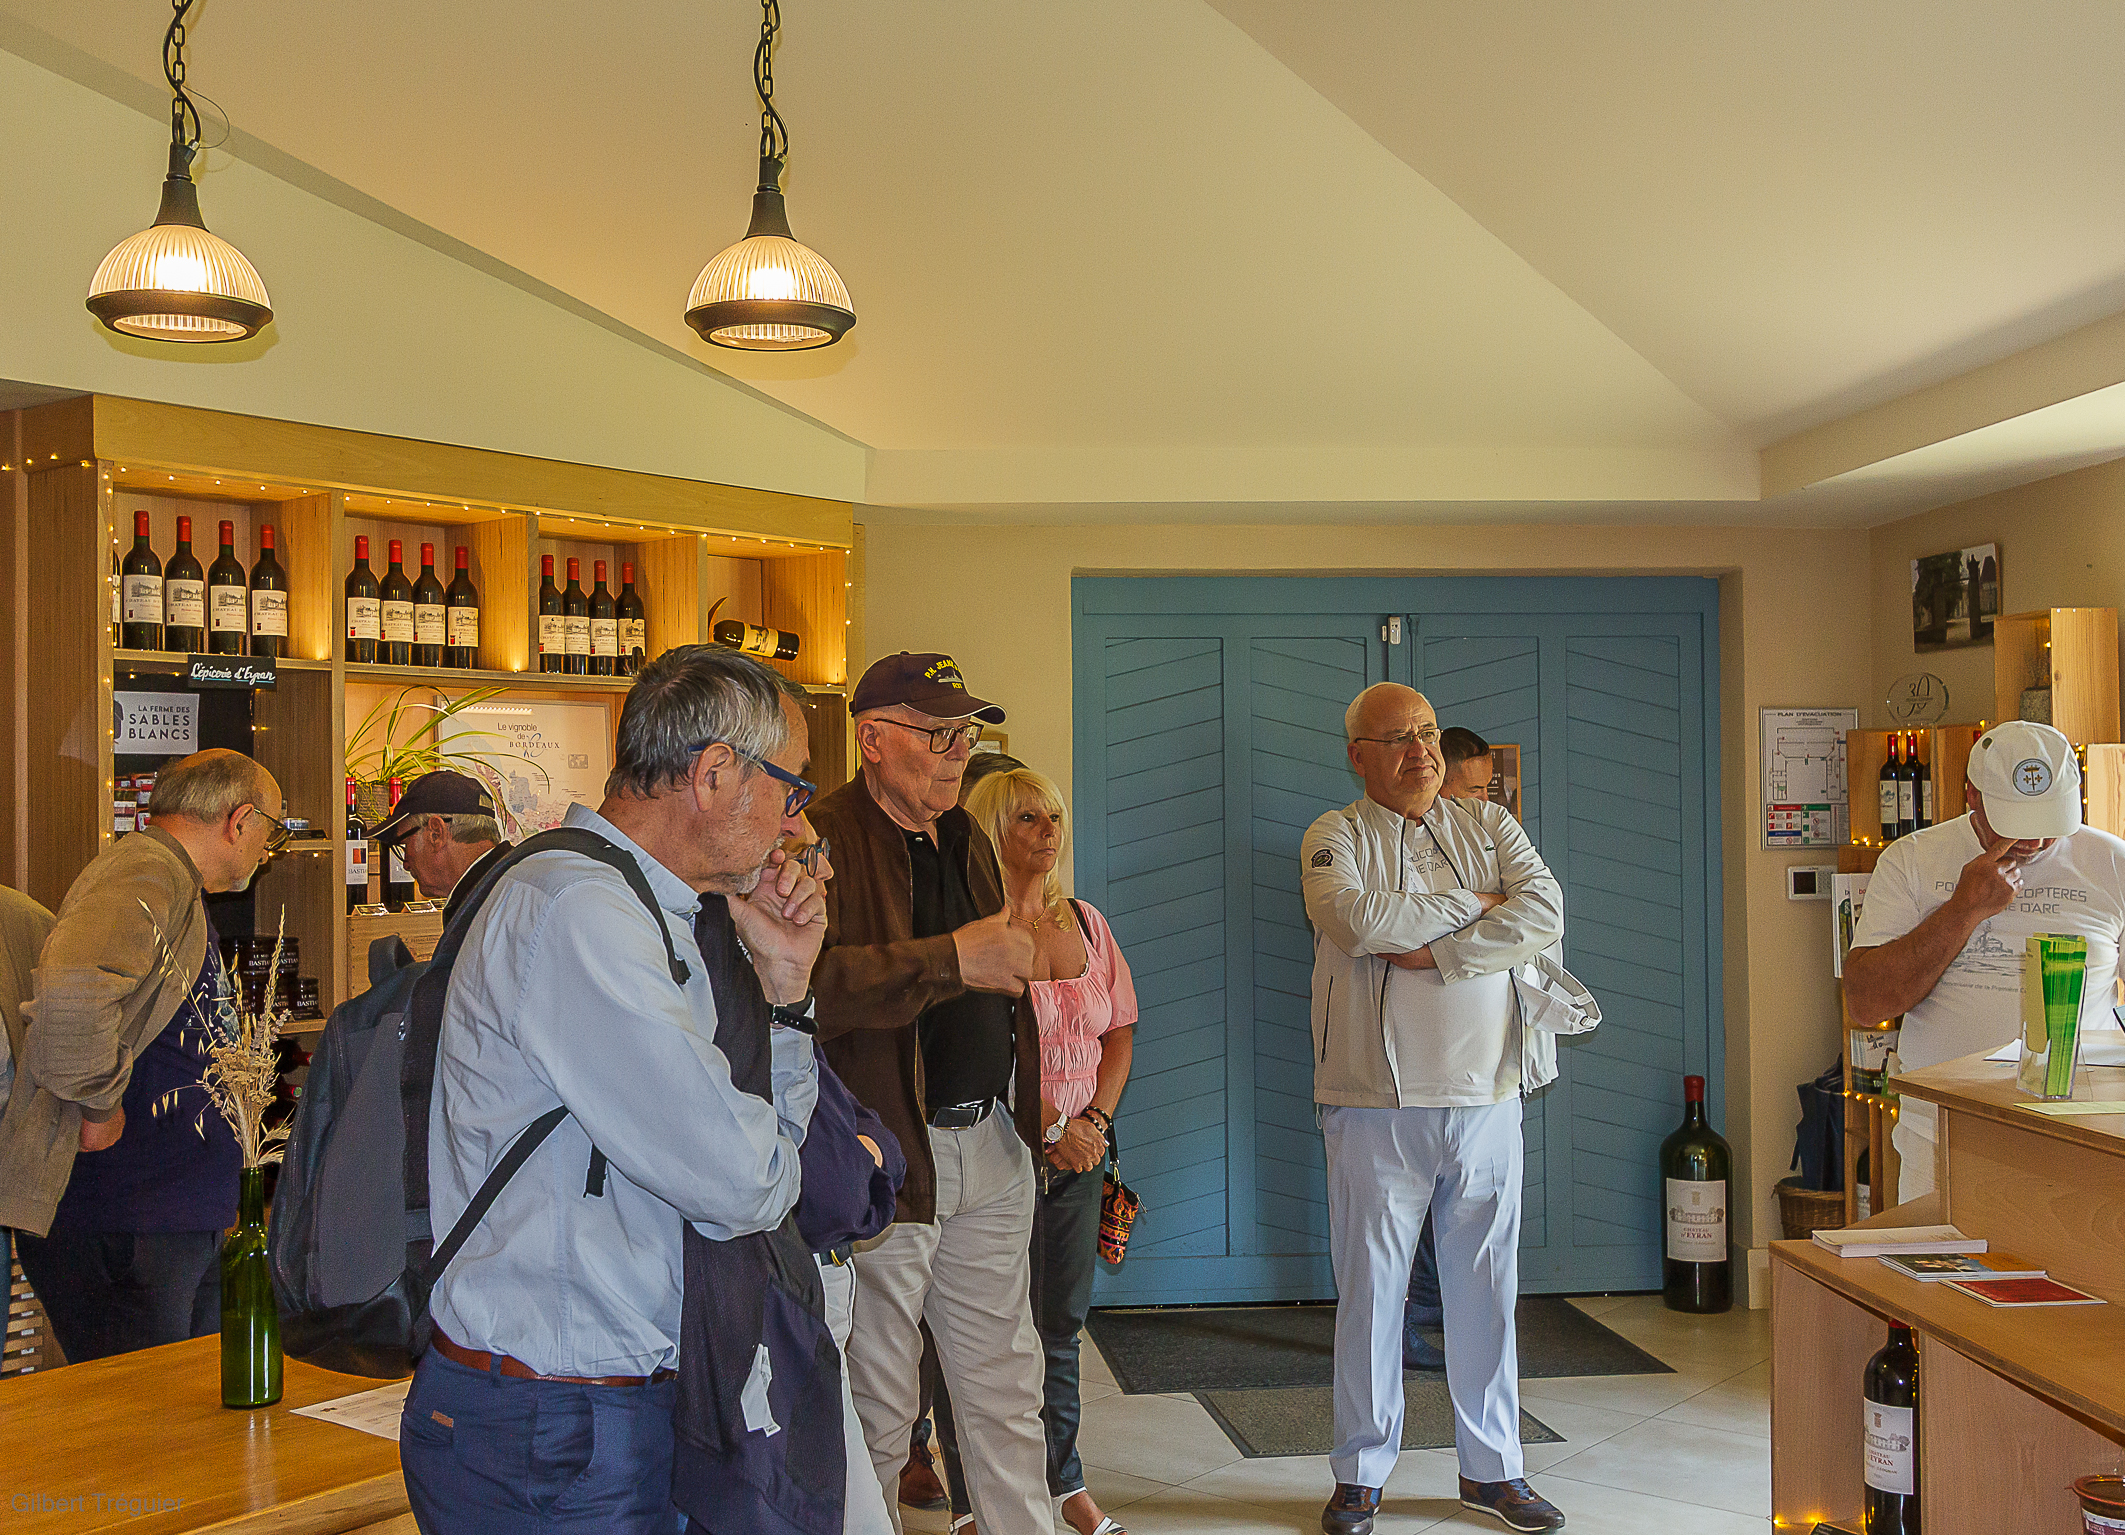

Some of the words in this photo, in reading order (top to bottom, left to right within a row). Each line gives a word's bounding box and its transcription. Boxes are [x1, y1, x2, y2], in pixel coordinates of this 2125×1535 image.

[150, 705, 174, 713] FERME
[129, 713, 190, 726] SABLES
[129, 727, 190, 740] BLANCS
[497, 722, 507, 731] Le
[508, 723, 538, 733] vignoble
[509, 741, 560, 749] BORDEAUX
[2016, 886, 2088, 903] COPTERES
[2020, 903, 2061, 915] D'ARC
